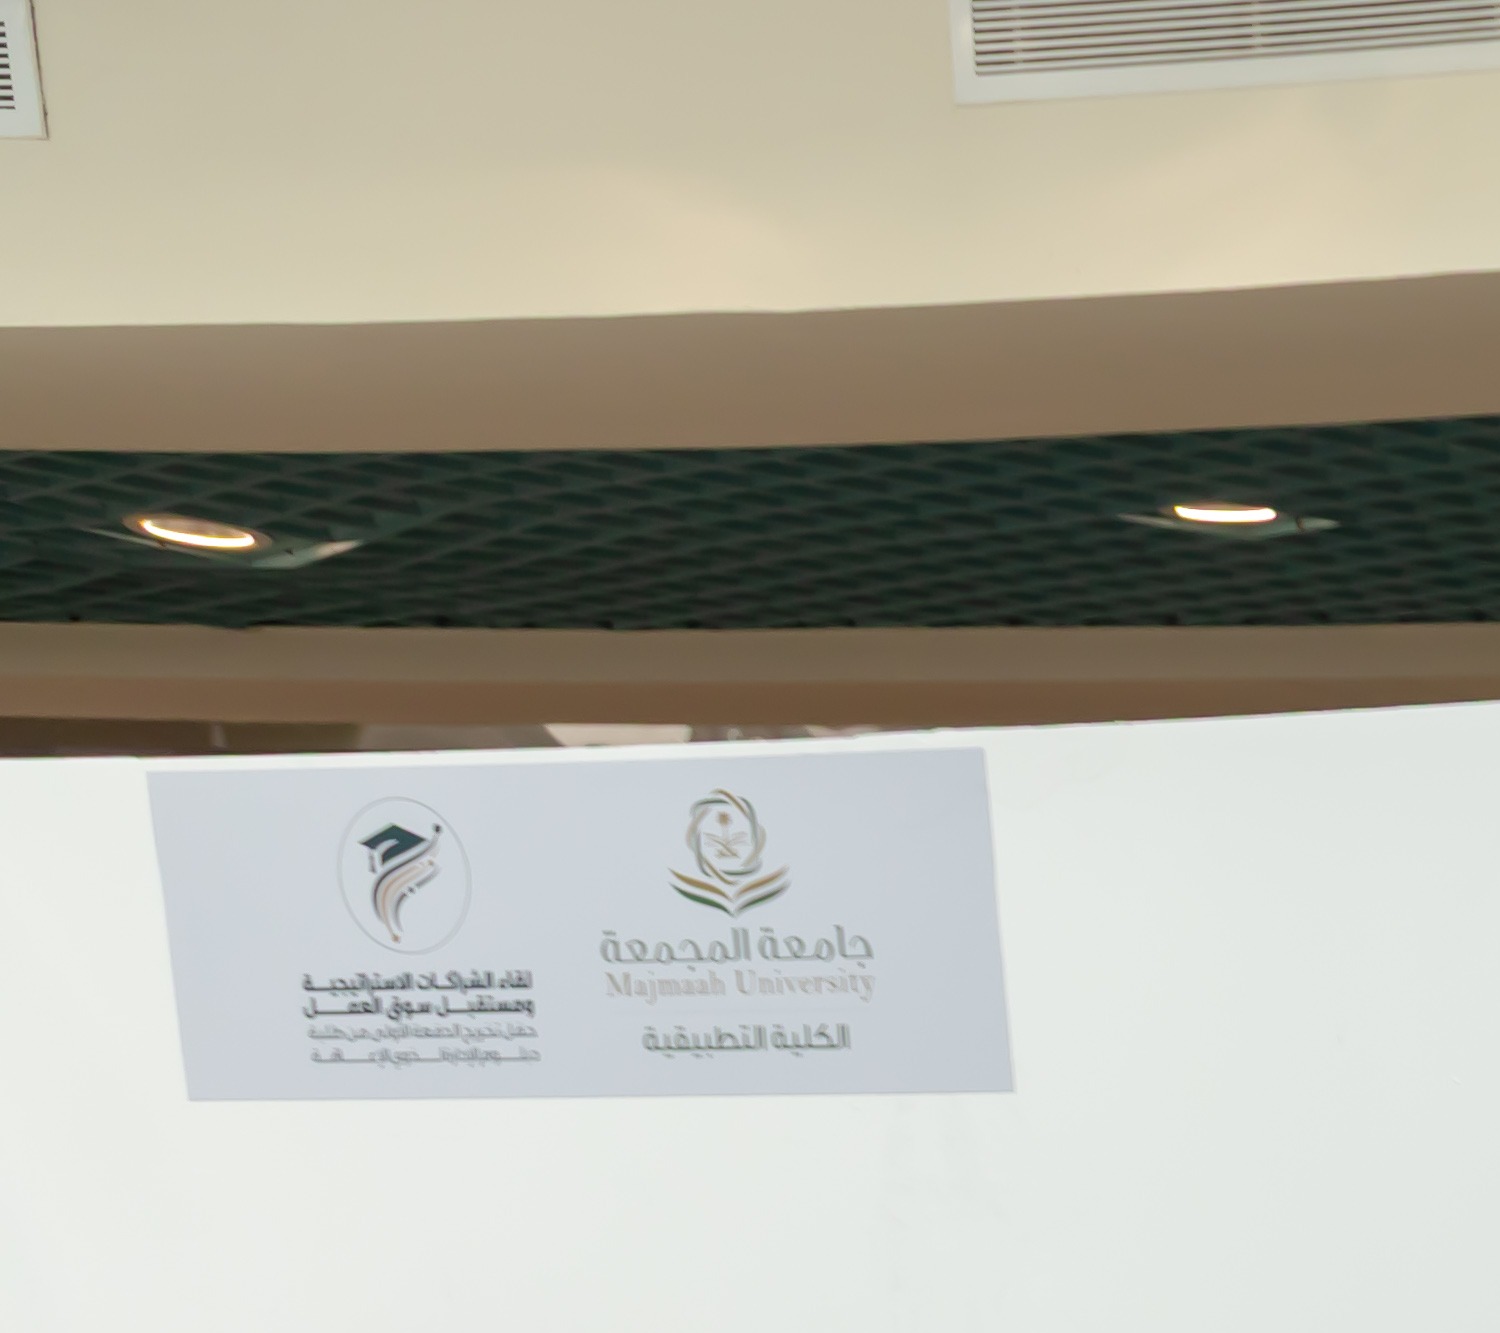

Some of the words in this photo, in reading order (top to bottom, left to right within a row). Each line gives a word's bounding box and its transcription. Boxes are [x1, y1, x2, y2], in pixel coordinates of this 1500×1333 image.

[599, 927, 752, 972] المجمعة
[758, 924, 875, 969] جامعة
[605, 970, 727, 1005] Majmaah
[734, 967, 876, 1003] University
[641, 1024, 768, 1059] التطبيقية
[770, 1023, 851, 1058] الكلية
